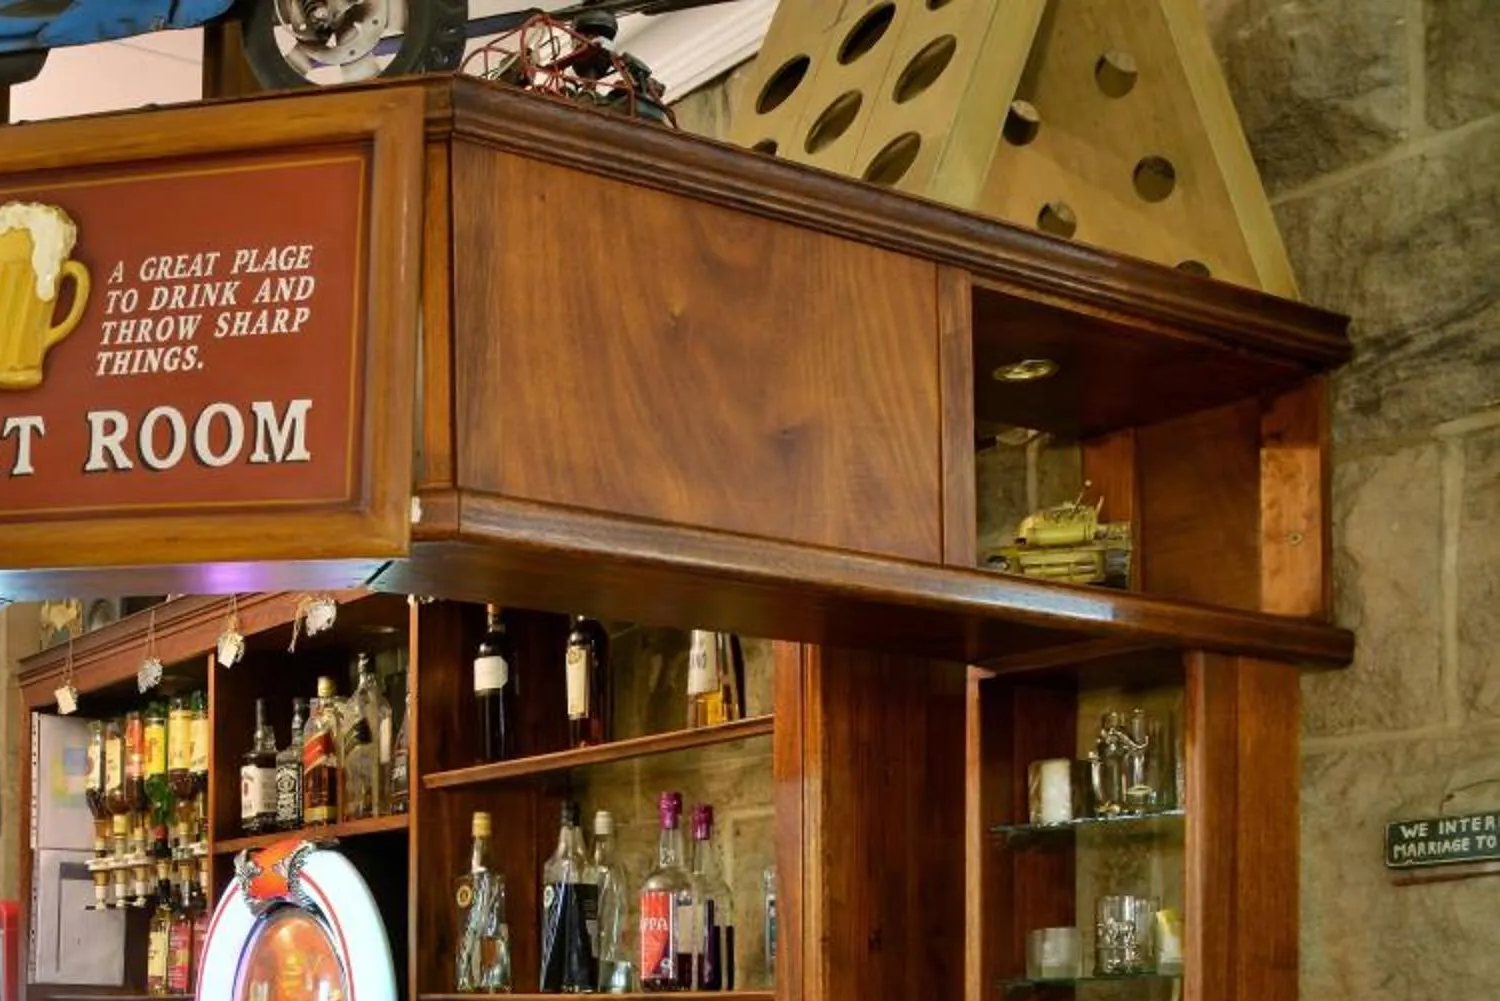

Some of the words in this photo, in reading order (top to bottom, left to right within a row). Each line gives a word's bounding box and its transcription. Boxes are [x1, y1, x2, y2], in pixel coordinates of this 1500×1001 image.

[108, 260, 125, 284] A
[139, 252, 221, 282] GREAT
[104, 288, 139, 315] TO
[148, 280, 242, 311] DRINK
[252, 275, 315, 304] AND
[99, 314, 203, 346] THROW
[213, 307, 311, 339] SHARP
[95, 345, 205, 377] THINGS.
[84, 399, 313, 474] ROOM
[1399, 823, 1429, 839] WE
[1438, 815, 1500, 835] INTER
[1392, 837, 1471, 859] MARRIAGE
[1475, 835, 1498, 849] TO
